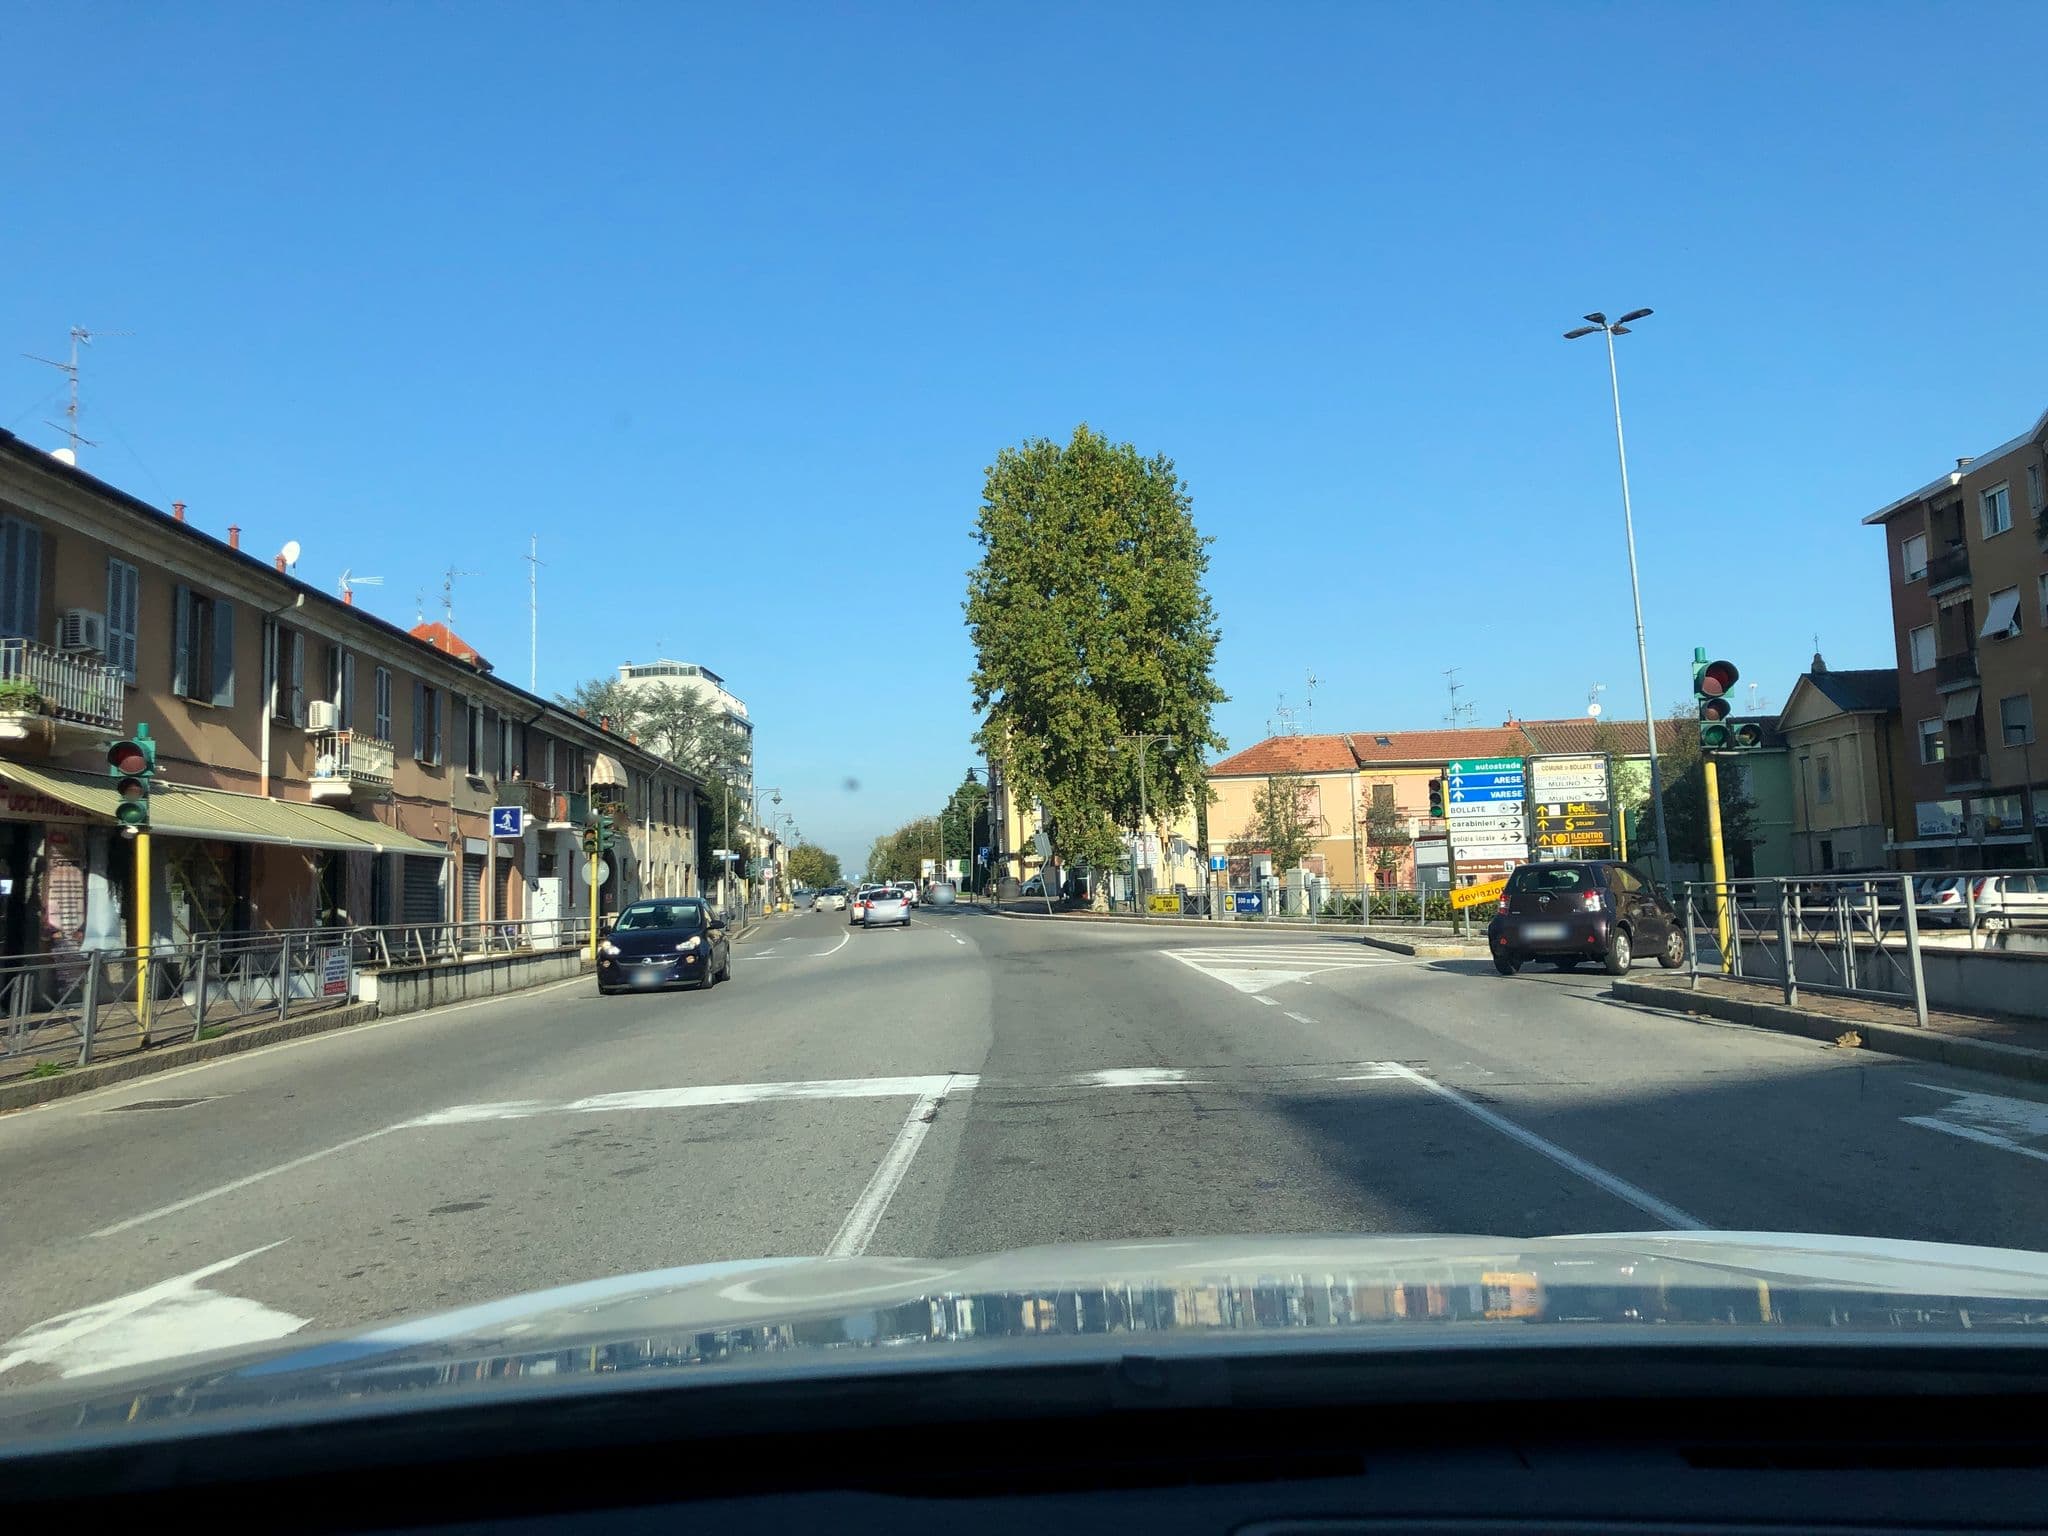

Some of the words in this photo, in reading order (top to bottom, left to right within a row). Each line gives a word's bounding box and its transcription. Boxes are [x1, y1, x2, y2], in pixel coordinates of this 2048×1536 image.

[1493, 775, 1522, 784] ARESE
[1490, 789, 1523, 799] VARESE
[1450, 806, 1486, 814] BOLLATE
[1451, 819, 1496, 828] carabinieri
